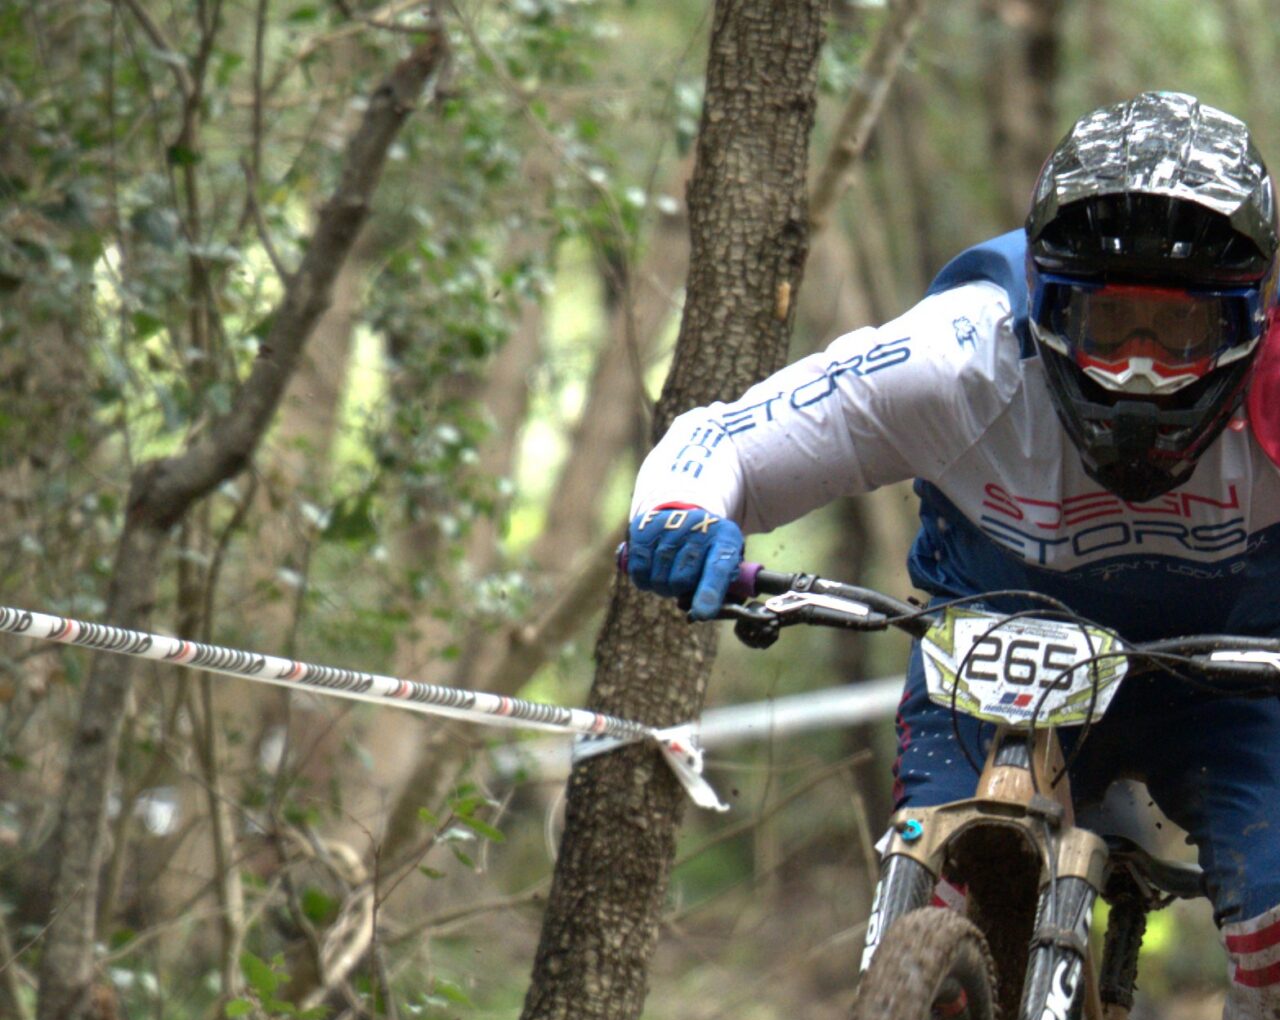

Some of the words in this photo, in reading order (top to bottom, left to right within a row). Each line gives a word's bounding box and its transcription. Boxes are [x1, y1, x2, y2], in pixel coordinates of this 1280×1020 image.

[638, 510, 719, 533] FOX
[1166, 563, 1226, 580] LOOK
[965, 635, 1078, 690] 265
